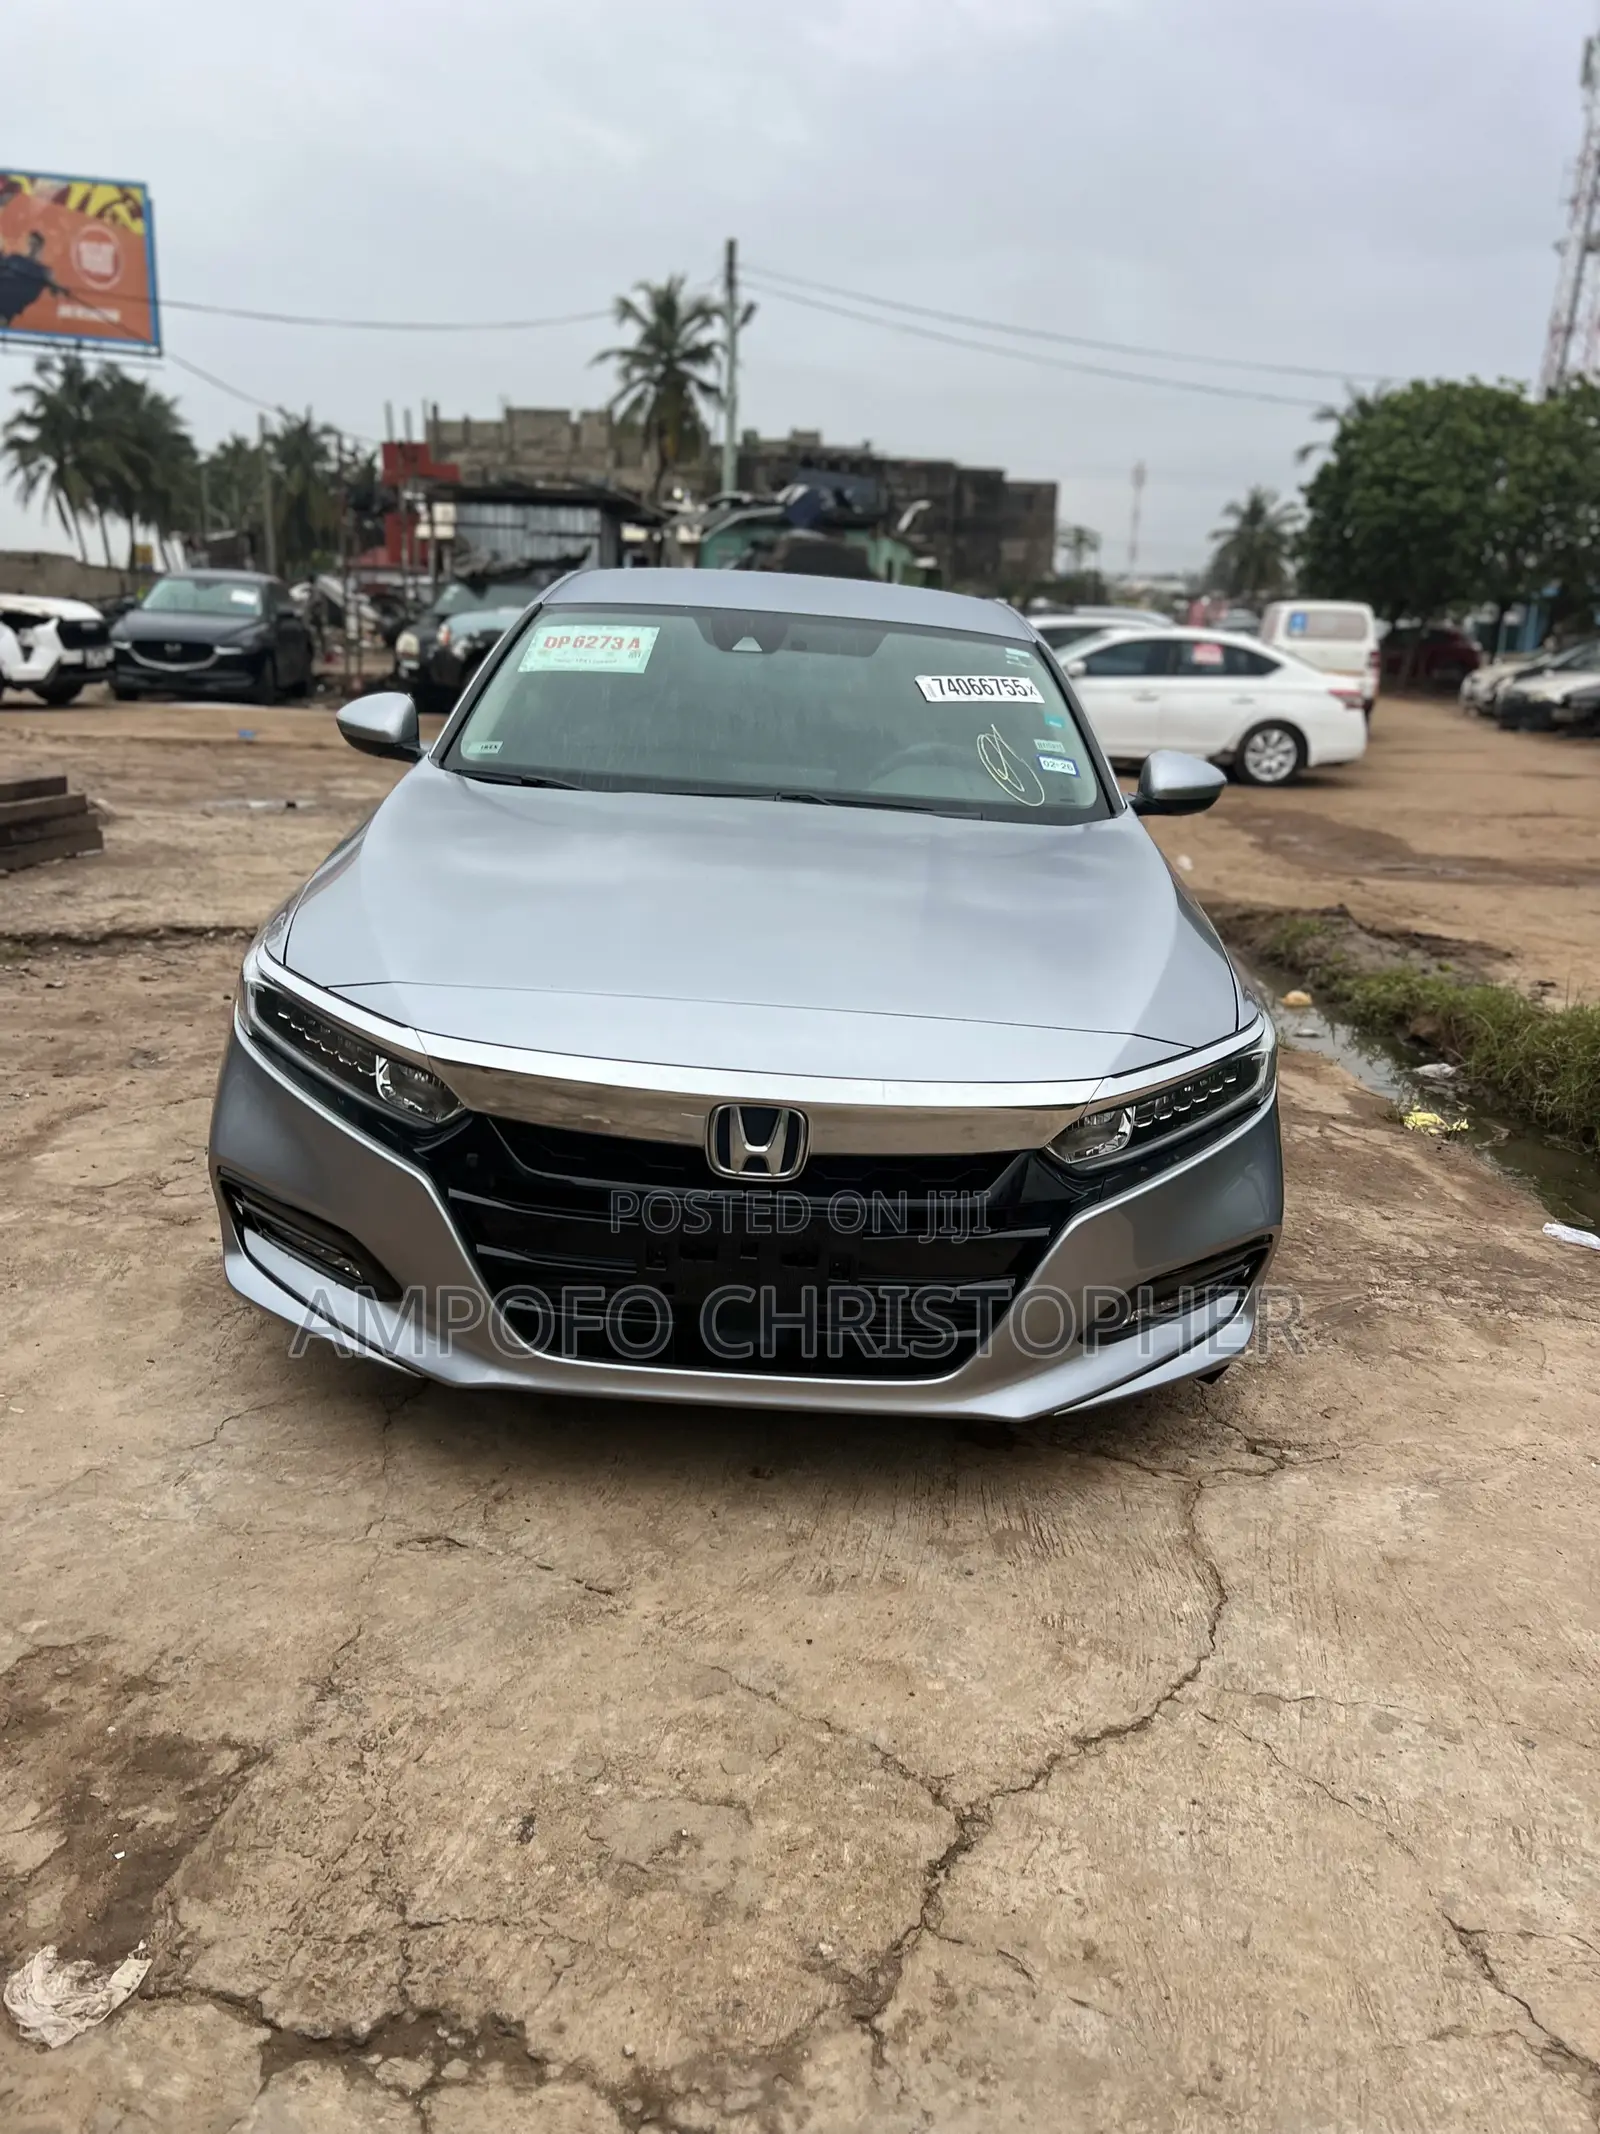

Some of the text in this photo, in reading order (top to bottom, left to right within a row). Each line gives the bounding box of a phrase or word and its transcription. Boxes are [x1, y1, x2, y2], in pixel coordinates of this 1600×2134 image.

[543, 635, 641, 650] DP 6273 A
[931, 678, 1028, 697] 74066755
